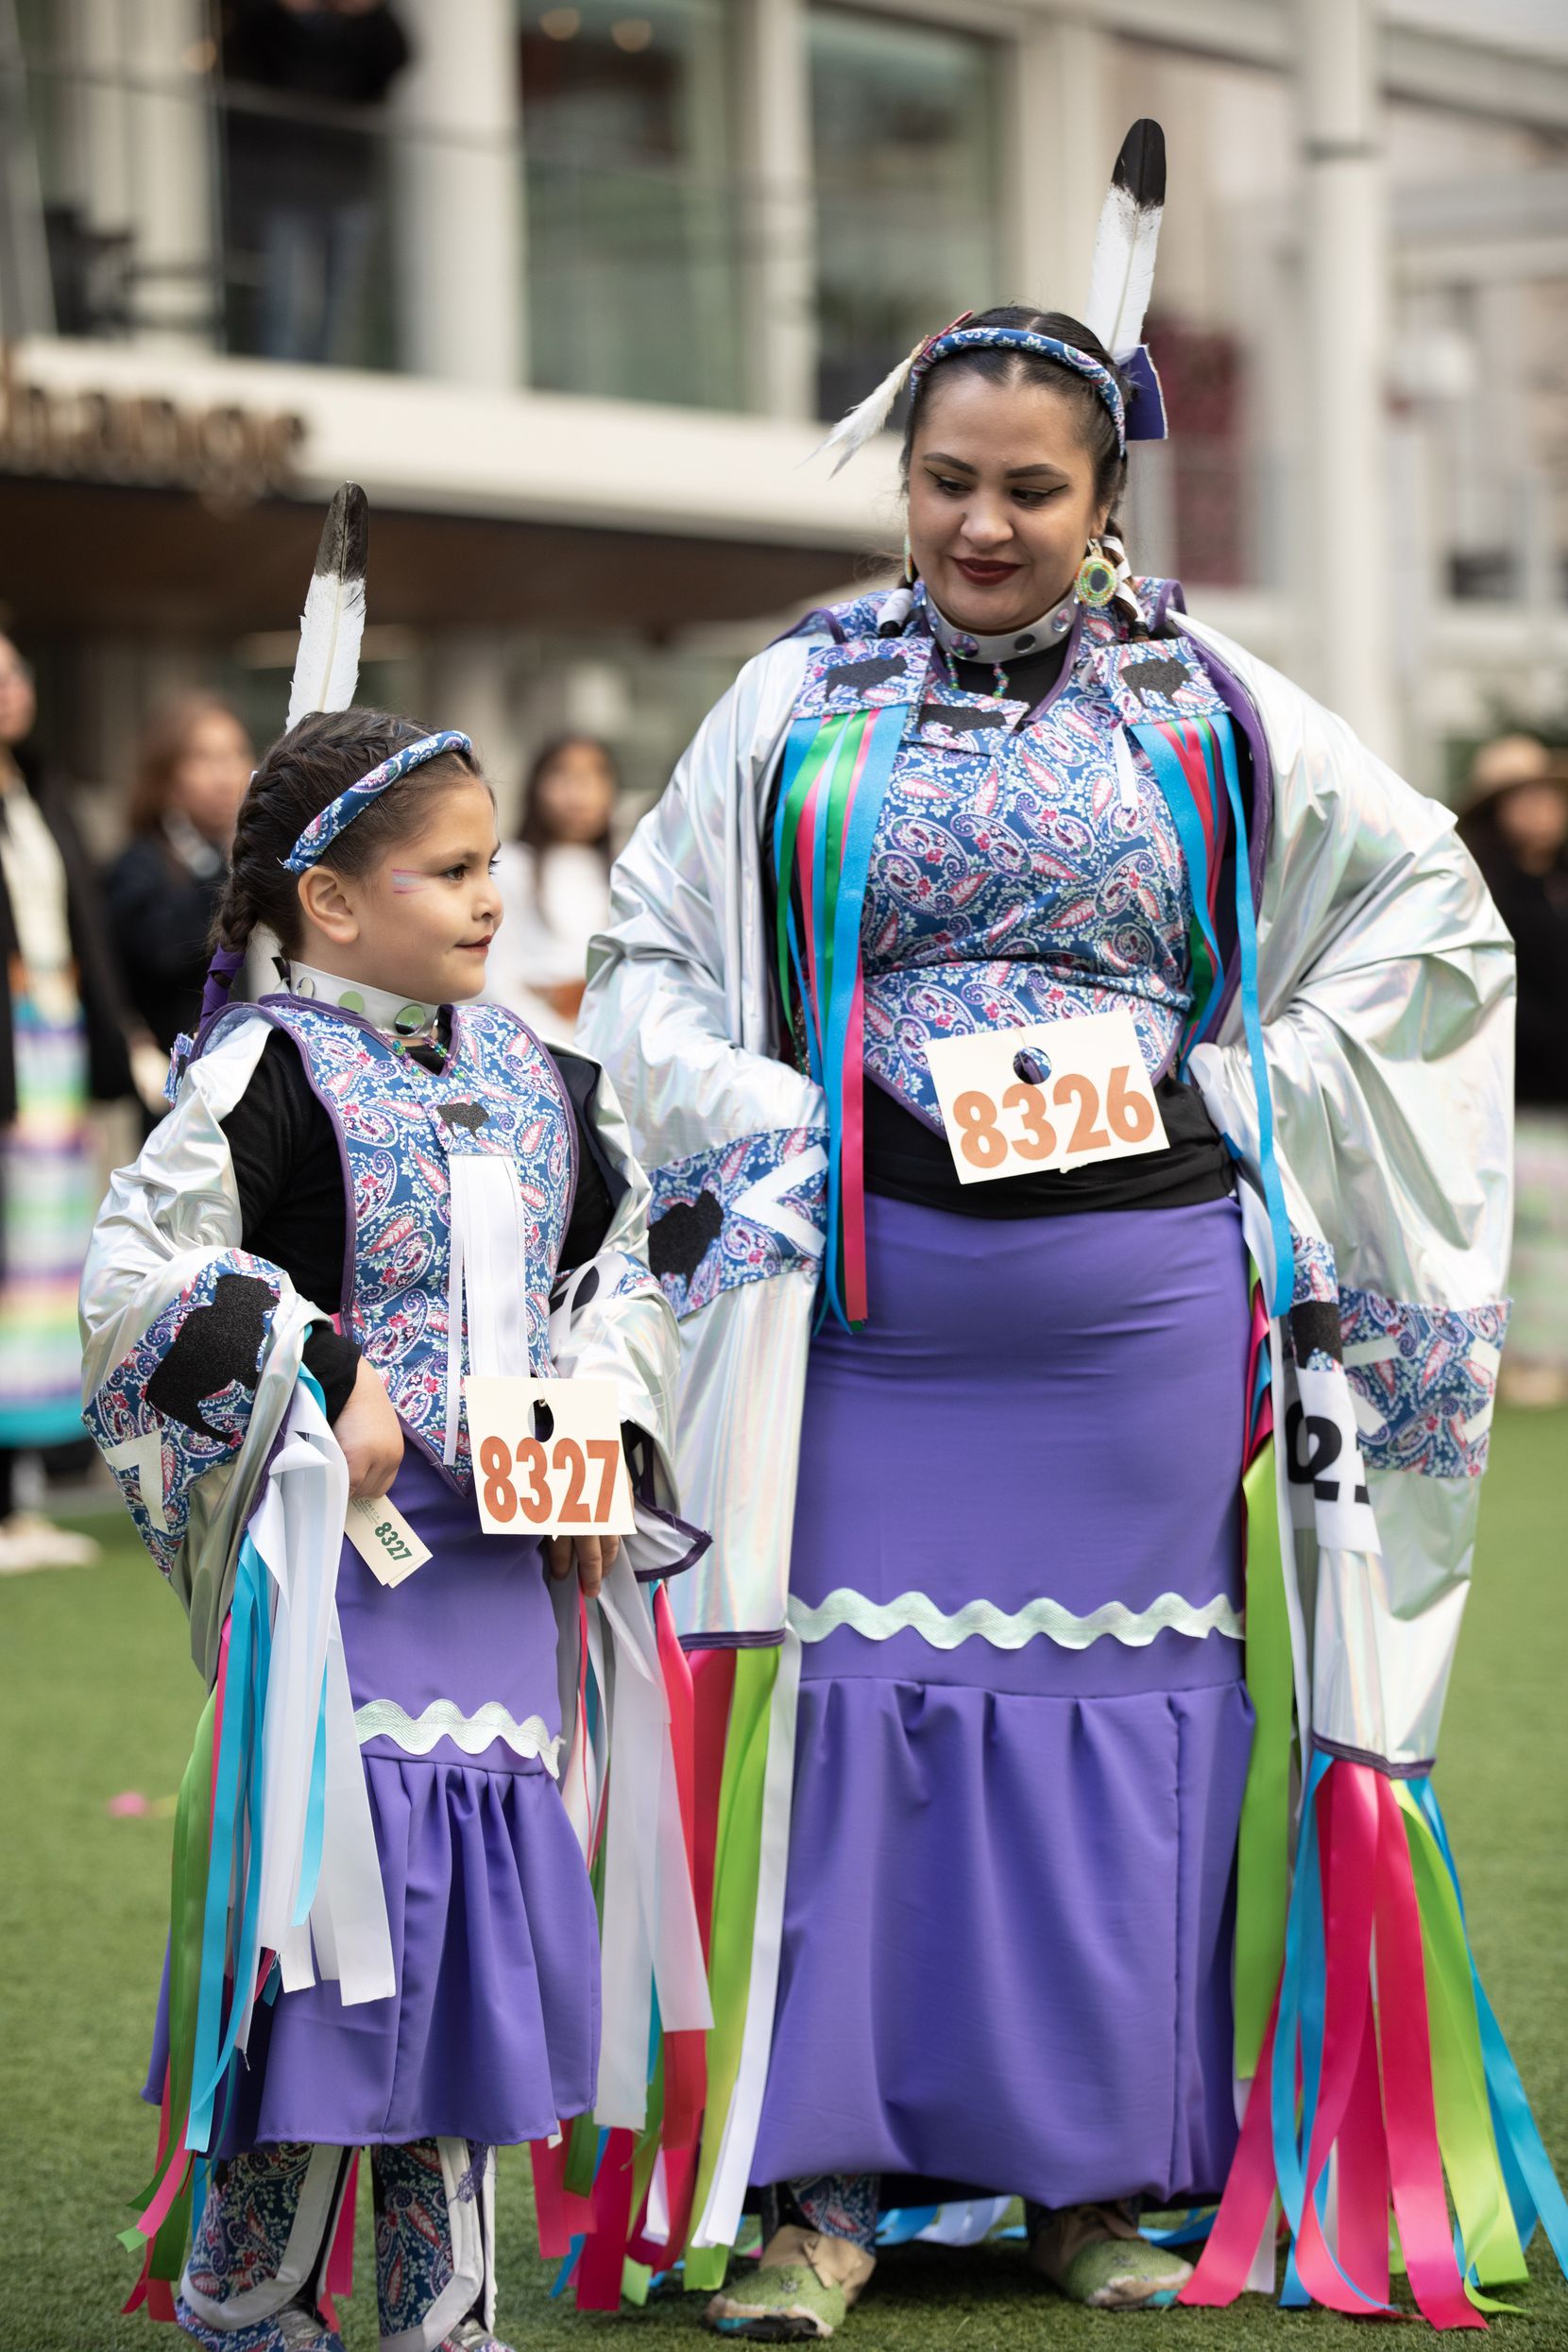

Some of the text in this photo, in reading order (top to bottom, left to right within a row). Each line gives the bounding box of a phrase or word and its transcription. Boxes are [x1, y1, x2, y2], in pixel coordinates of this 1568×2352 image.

[952, 1065, 1154, 1168] 8326
[480, 1436, 620, 1524] 8327
[375, 1522, 412, 1560] 8327
